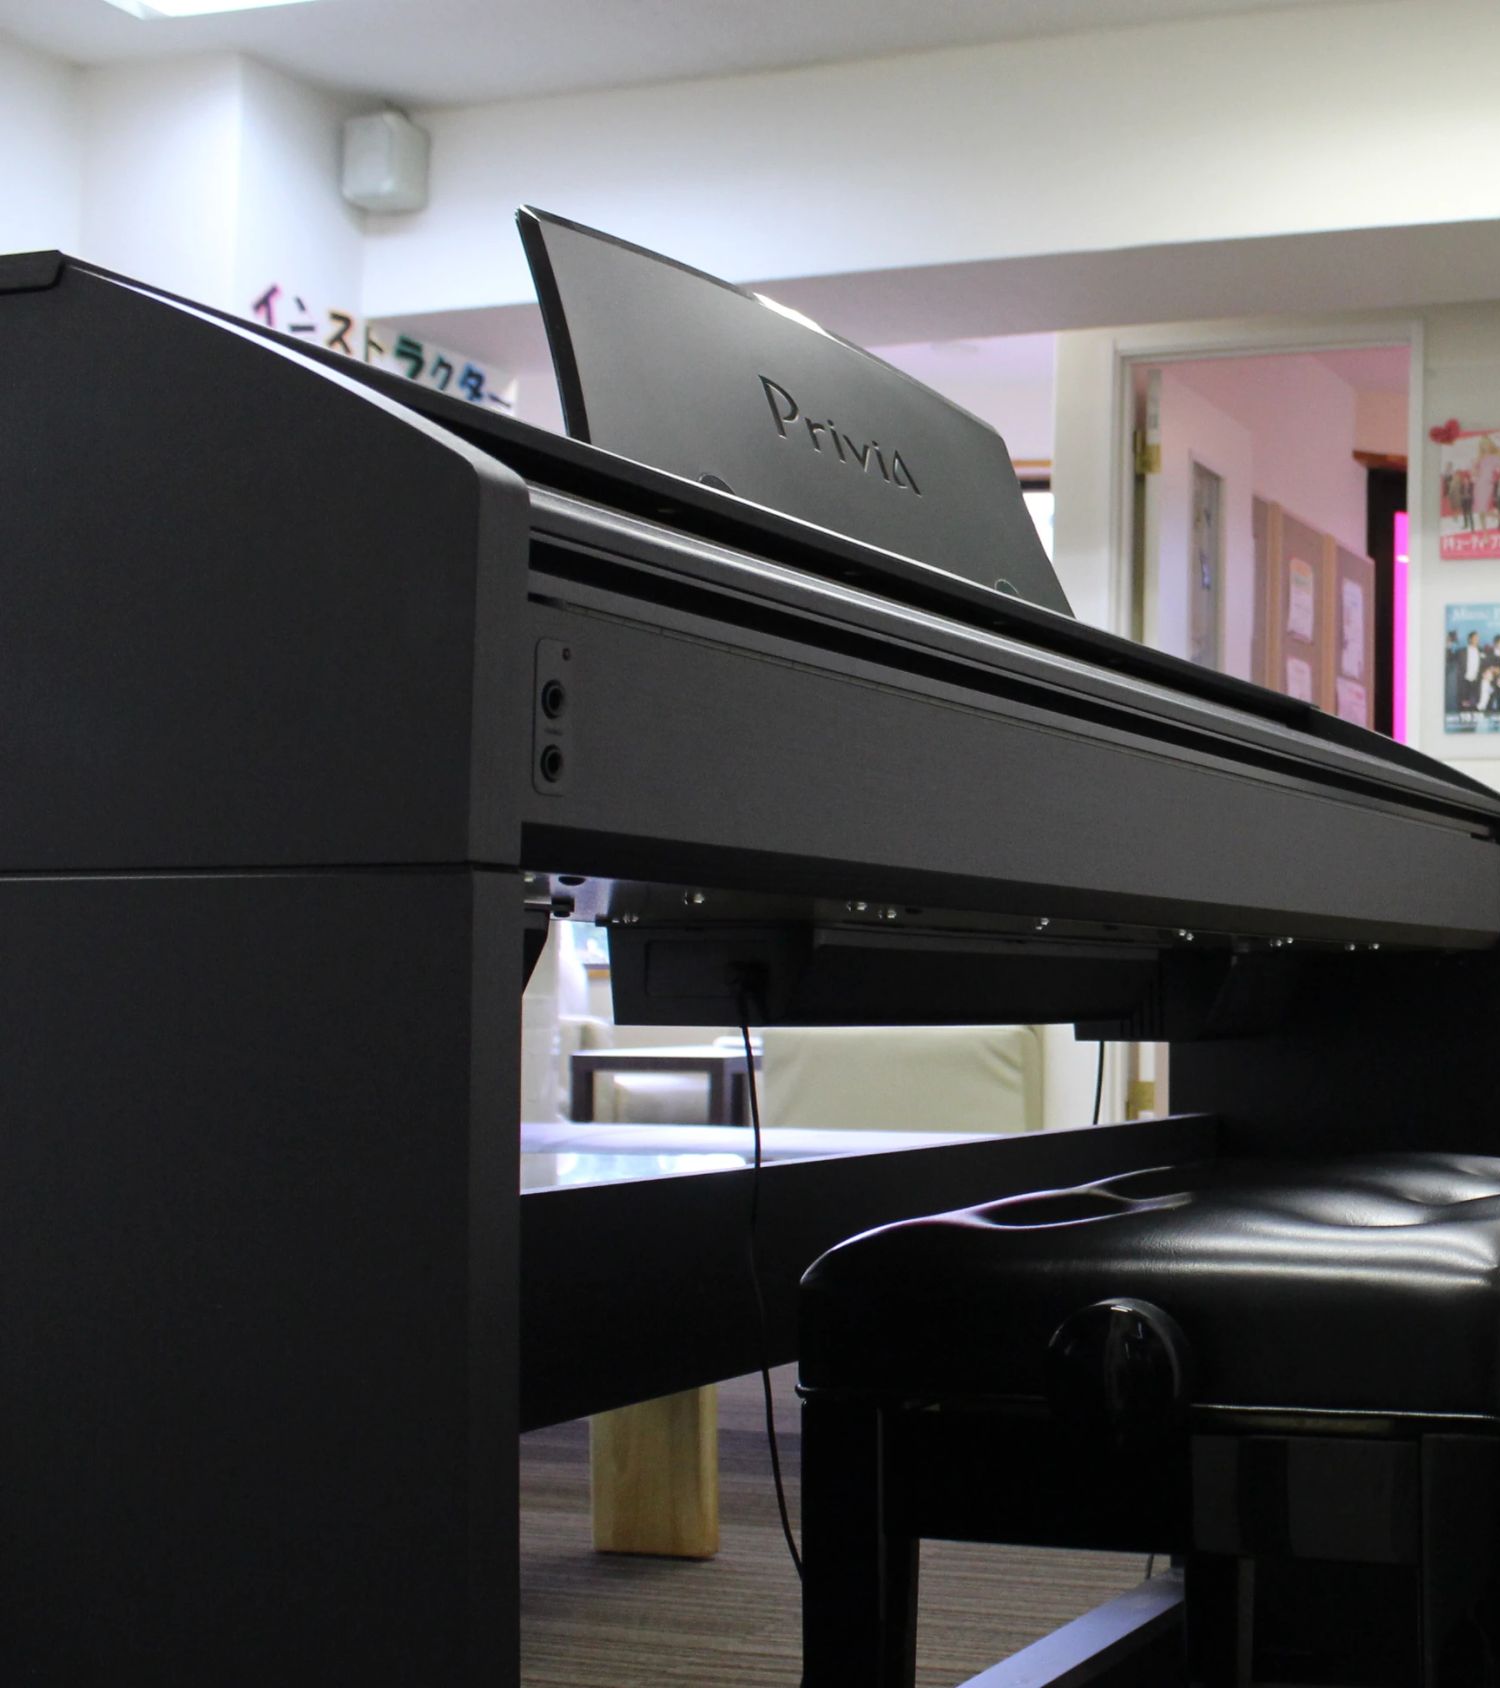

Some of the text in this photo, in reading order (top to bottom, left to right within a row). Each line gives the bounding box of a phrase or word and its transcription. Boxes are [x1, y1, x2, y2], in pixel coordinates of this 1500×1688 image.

[252, 284, 513, 408] インストラクター
[758, 374, 922, 497] Privia
